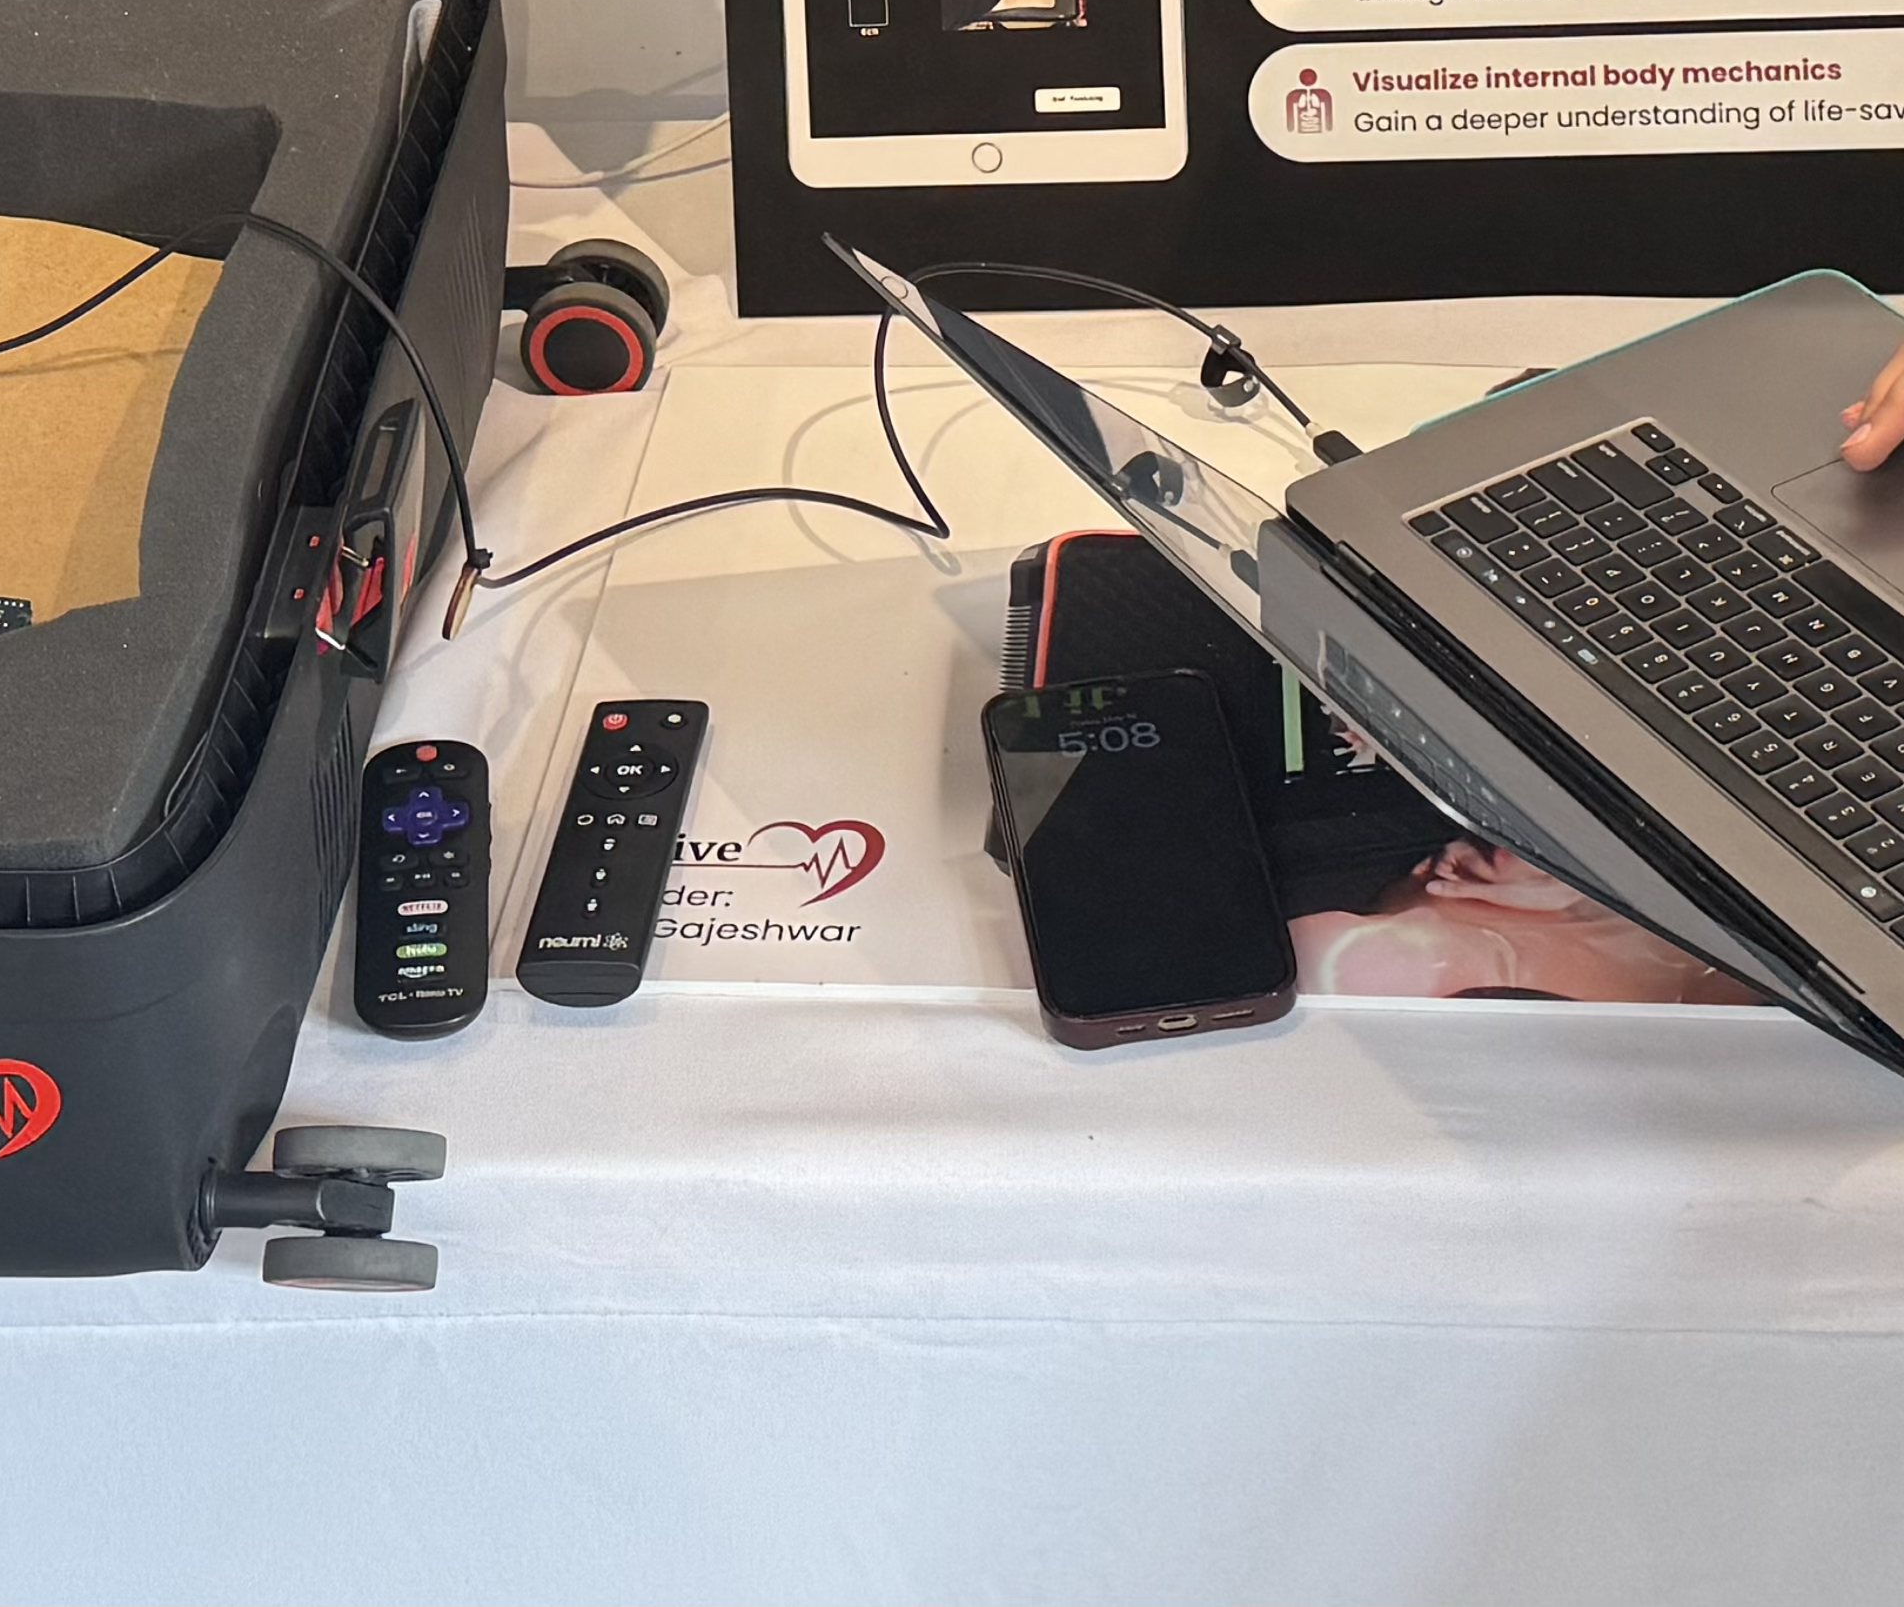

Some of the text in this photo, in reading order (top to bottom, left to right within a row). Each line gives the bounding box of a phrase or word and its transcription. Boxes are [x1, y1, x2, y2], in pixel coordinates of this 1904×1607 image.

[1353, 58, 1842, 92] Visualize internal body mechanics
[1354, 110, 1416, 132] Gain
[1426, 115, 1442, 130] a
[1452, 109, 1548, 136] deeper
[1557, 102, 1759, 130] understanding
[1769, 100, 1795, 122] of
[1606, 569, 1621, 577] P
[1679, 569, 1691, 579] L
[1585, 597, 1599, 606] 0
[1640, 595, 1655, 604] O
[1711, 597, 1727, 606] K
[1772, 591, 1789, 603] M
[1808, 619, 1825, 630] N
[1620, 626, 1634, 635] 9
[1654, 654, 1669, 663] 8
[1709, 651, 1725, 662] U
[1782, 653, 1798, 664] H
[1847, 649, 1861, 659] B
[1690, 684, 1704, 693] 7
[1747, 682, 1760, 691] Y
[1820, 683, 1834, 692] G
[1883, 679, 1898, 689] V
[1727, 713, 1741, 722] 6
[1783, 711, 1798, 721] T
[1858, 715, 1873, 723] F
[1058, 722, 1160, 757] 5:08
[1763, 743, 1779, 753] 5
[1822, 741, 1838, 751] R
[617, 765, 642, 775] OK
[1860, 772, 1876, 782] E
[673, 833, 742, 862] ive
[661, 885, 733, 907] der:
[653, 917, 862, 946] Gajeshwar
[378, 992, 407, 1002] TCL
[448, 988, 463, 996] TV
